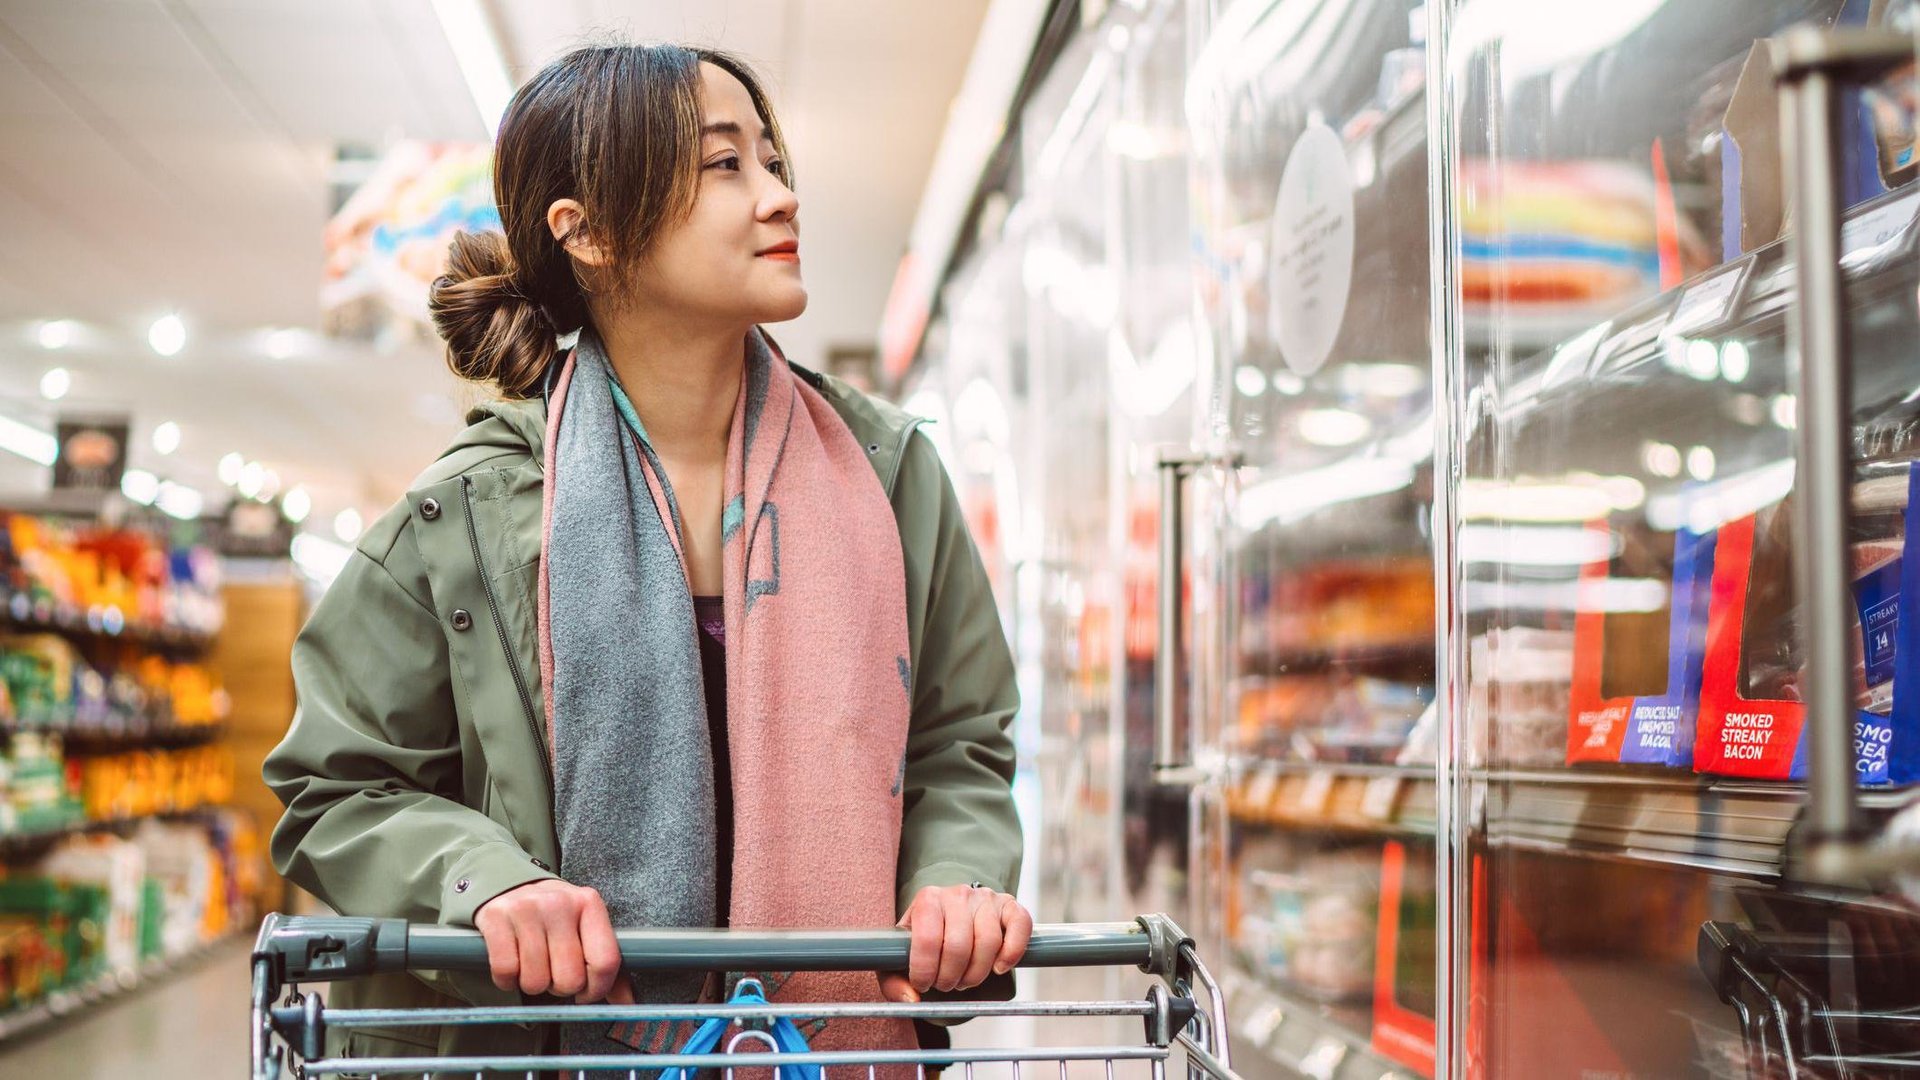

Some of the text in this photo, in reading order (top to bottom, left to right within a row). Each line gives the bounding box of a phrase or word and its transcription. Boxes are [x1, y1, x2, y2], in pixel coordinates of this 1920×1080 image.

[1868, 601, 1899, 625] STREAKY
[1875, 631, 1889, 651] 14
[1725, 713, 1774, 728] SMOKED
[1640, 734, 1672, 748] BACON
[1721, 728, 1774, 744] STREAKY
[1723, 744, 1764, 760] BACON
